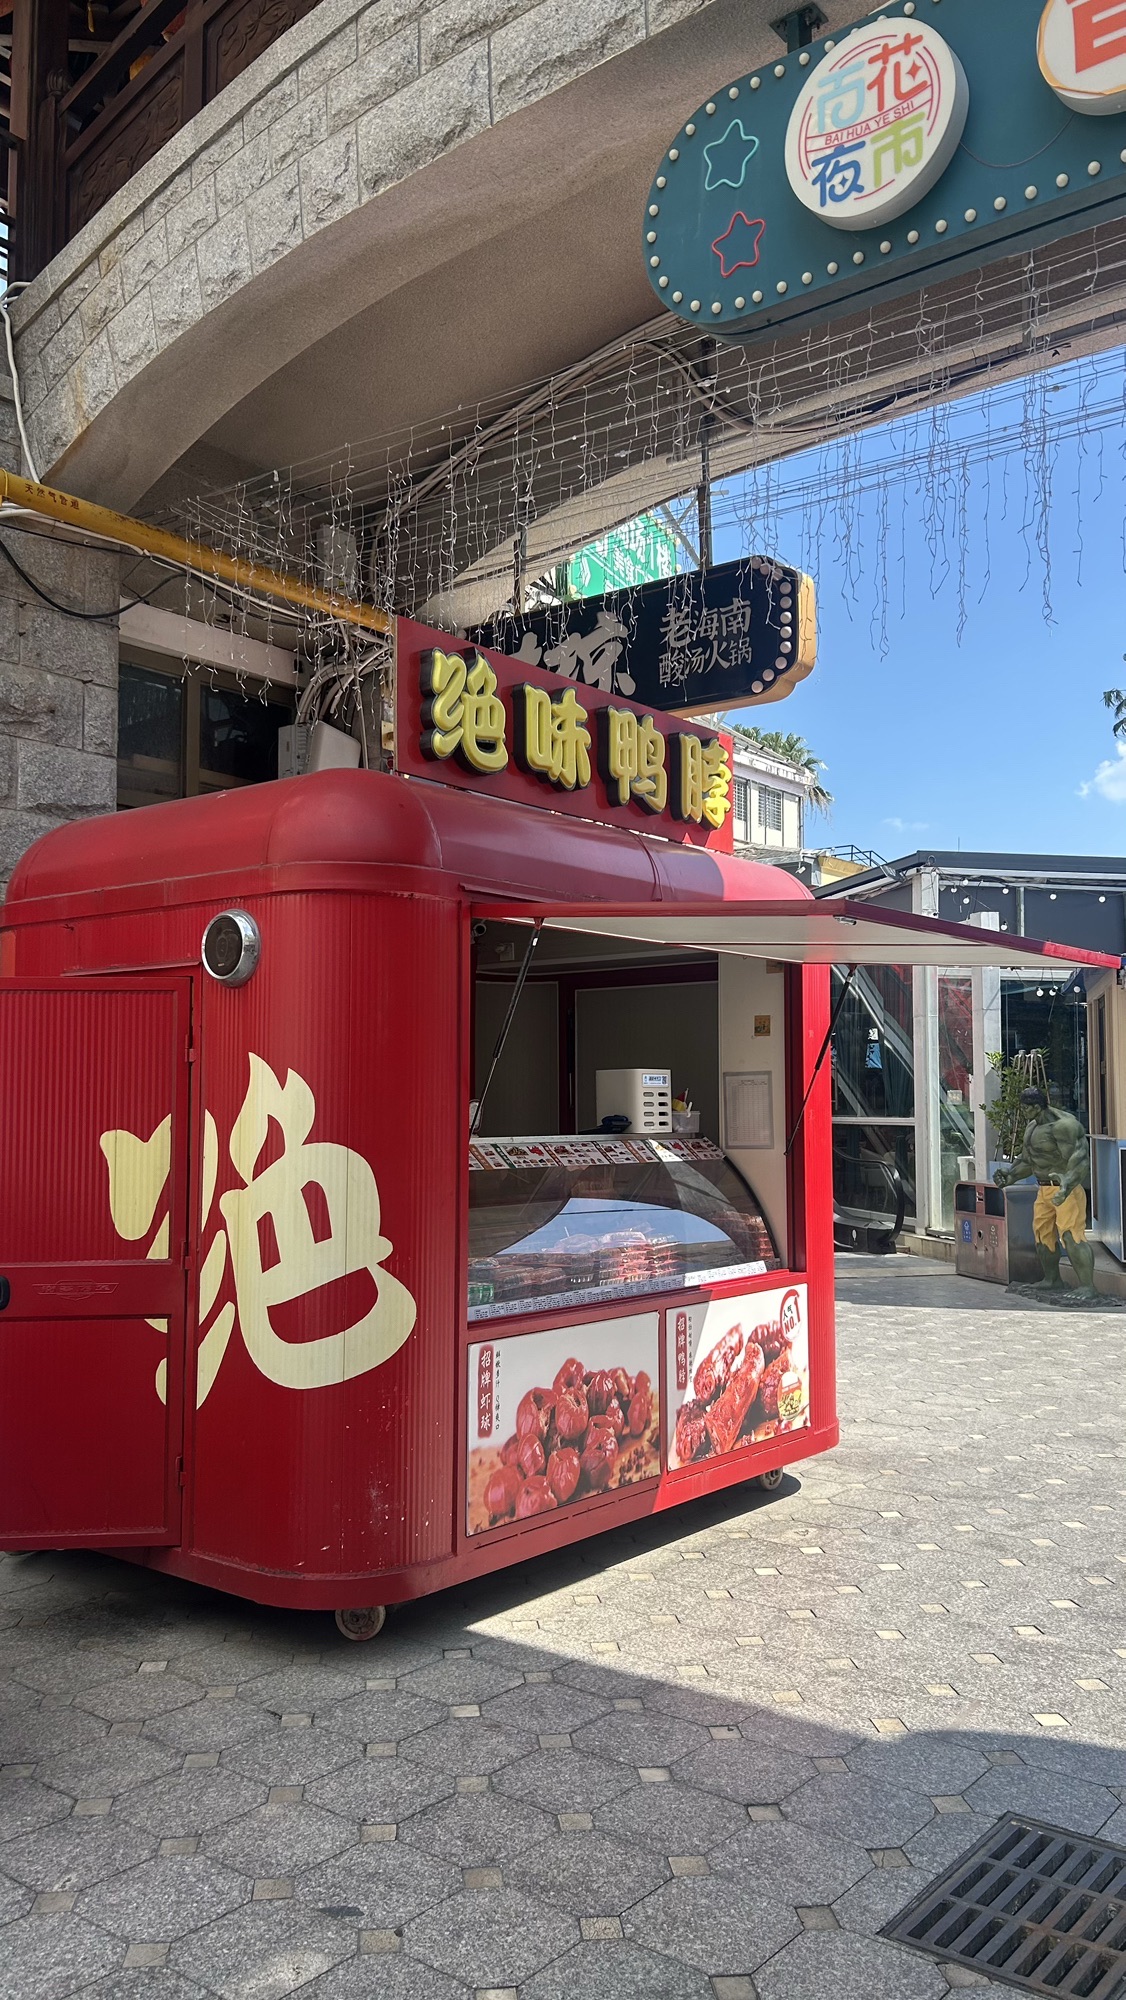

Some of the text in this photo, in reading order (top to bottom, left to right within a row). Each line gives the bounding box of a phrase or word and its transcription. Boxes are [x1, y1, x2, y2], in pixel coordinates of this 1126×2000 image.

[811, 111, 926, 207] 夜市
[825, 100, 914, 145] BAI HUA YE SHI
[659, 597, 752, 648] 老海南
[659, 637, 752, 684] 酸汤火锅
[422, 648, 732, 830] 绝味鸭脖
[100, 1052, 416, 1409] 绝
[677, 1316, 686, 1384] 招牌鸭脖
[480, 1349, 491, 1431] 招牌虾球
